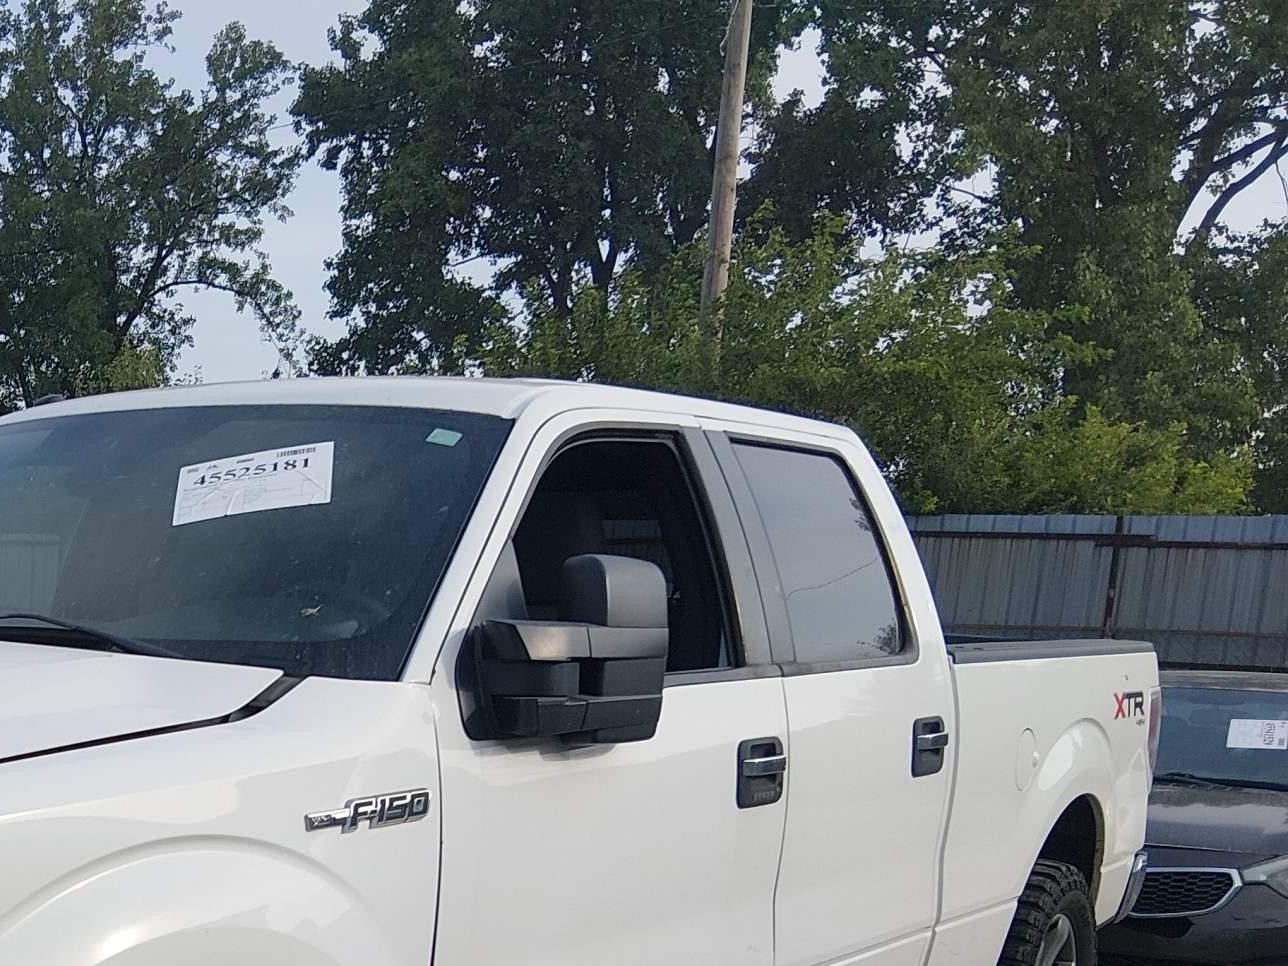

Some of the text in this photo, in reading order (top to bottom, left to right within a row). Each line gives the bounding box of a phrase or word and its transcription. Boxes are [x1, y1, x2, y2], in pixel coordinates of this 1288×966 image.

[193, 457, 311, 486] 45525181
[1113, 691, 1145, 720] XTR
[342, 788, 432, 834] F-150
